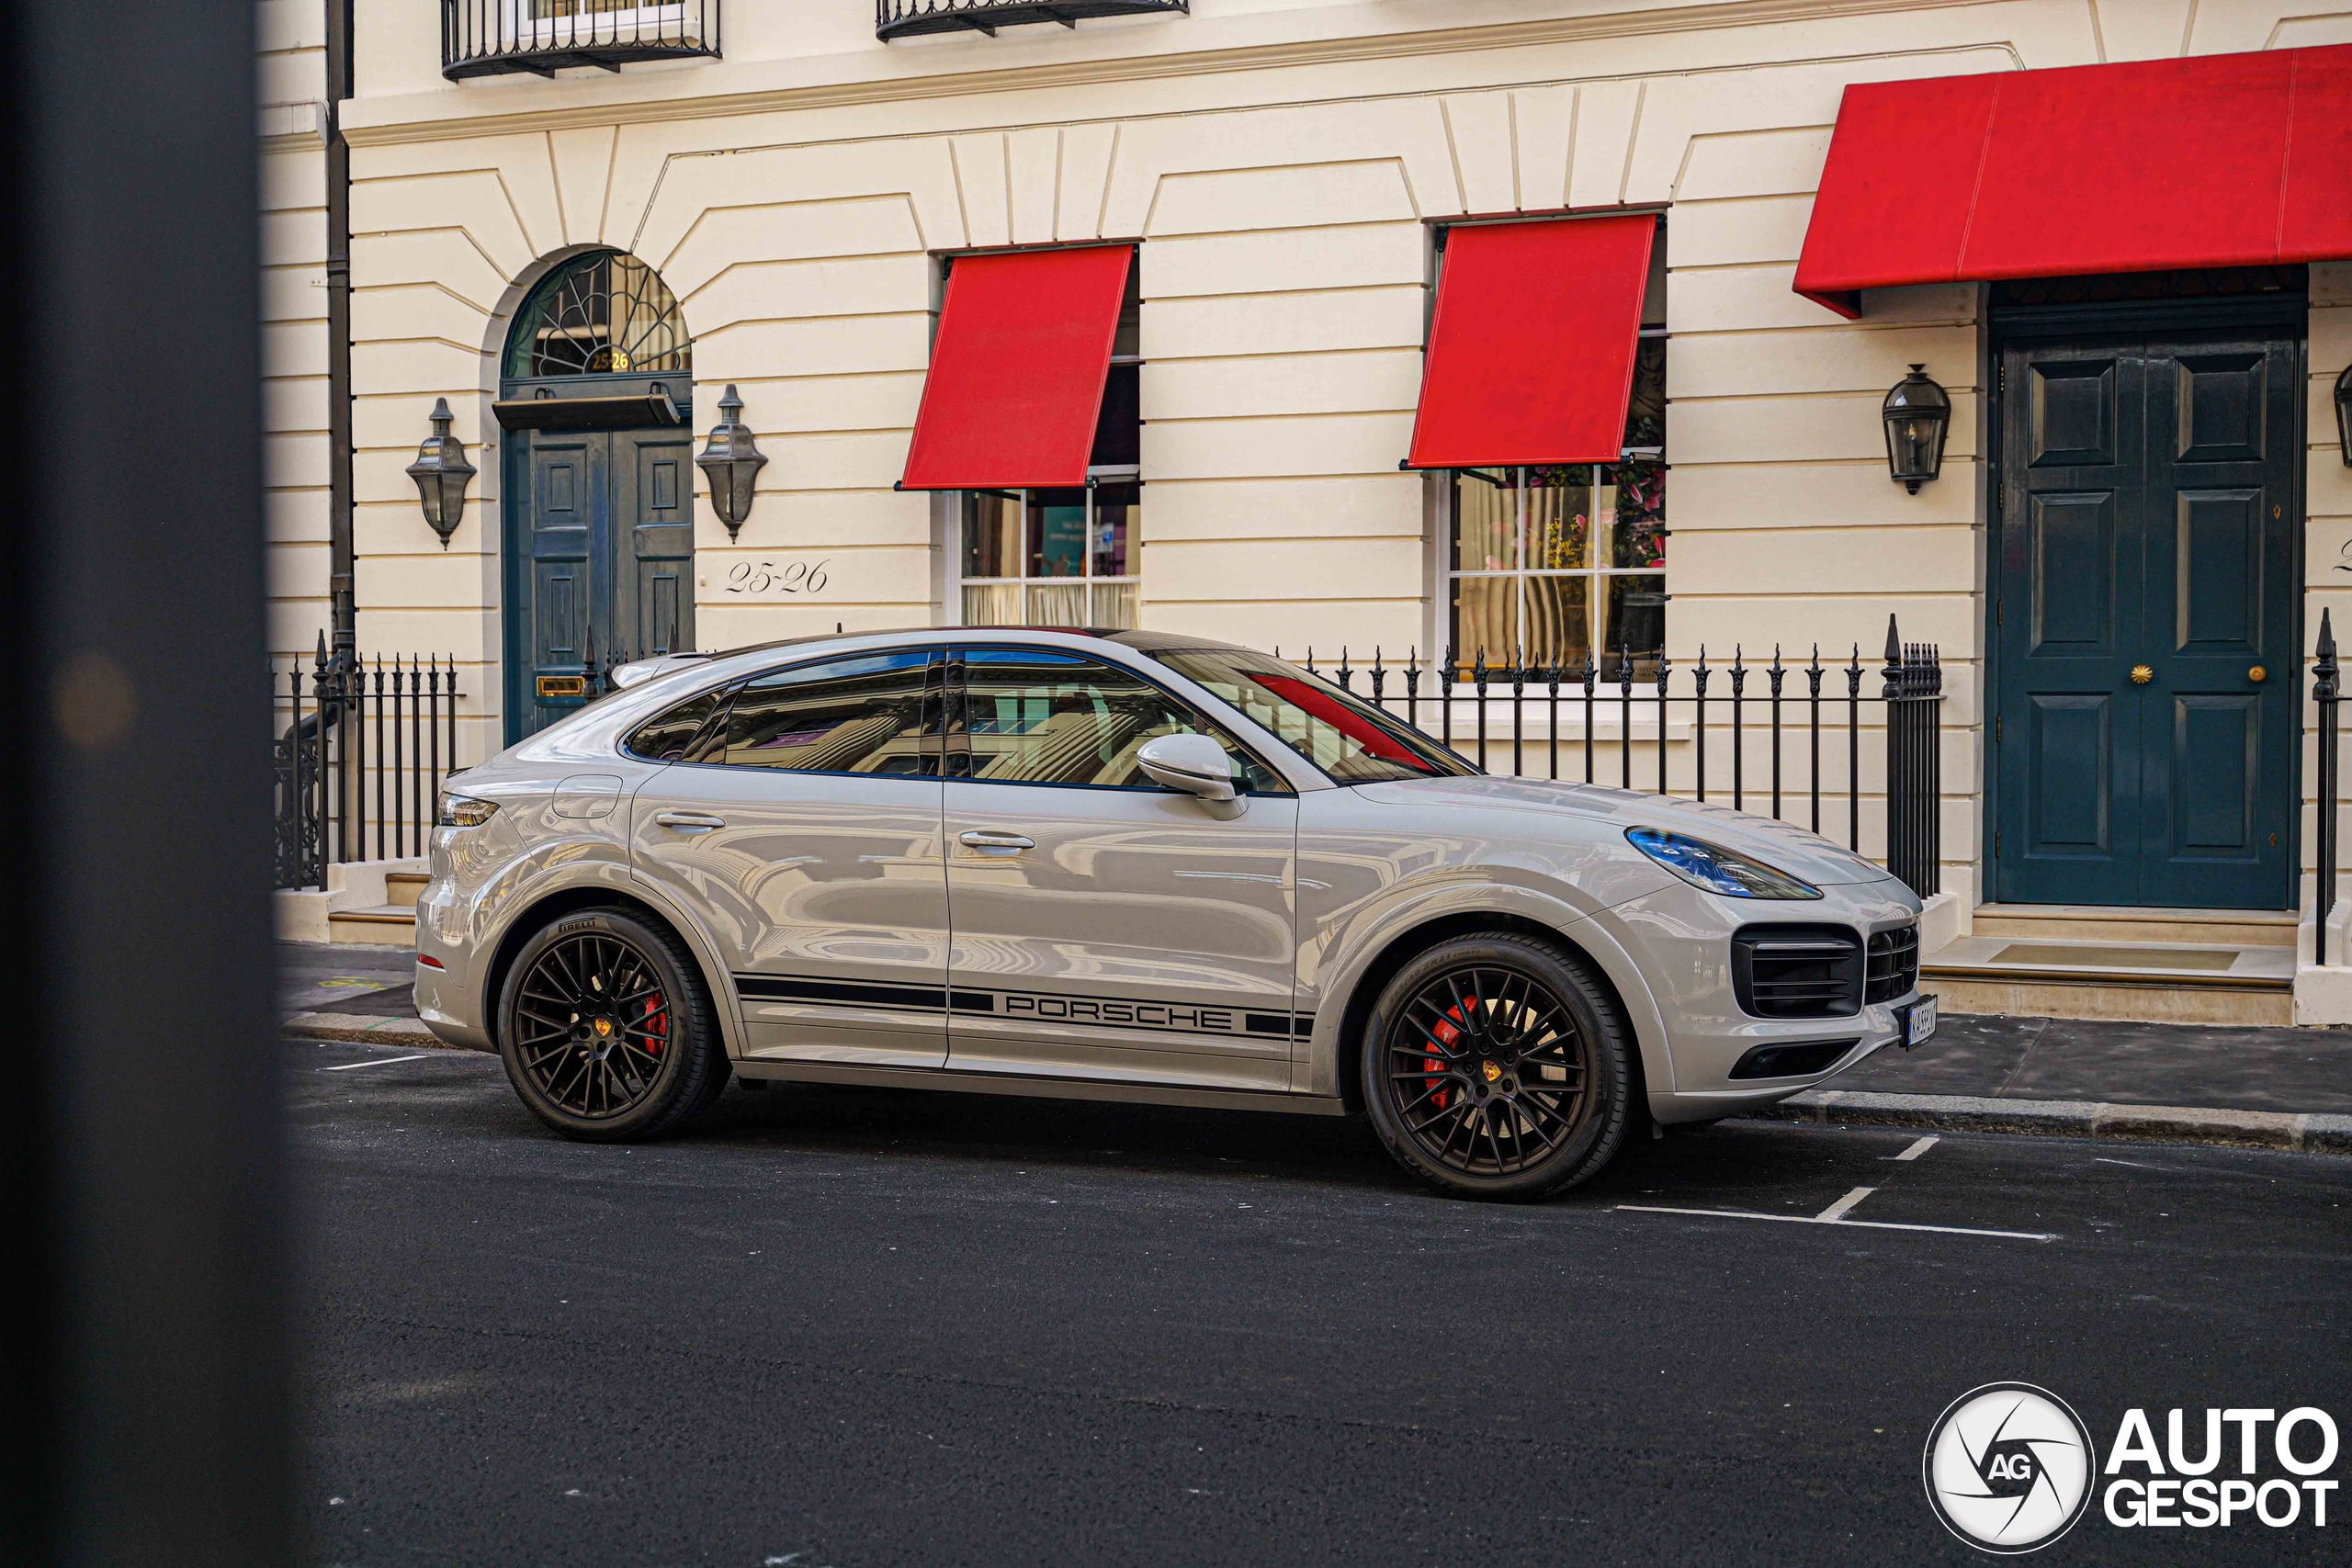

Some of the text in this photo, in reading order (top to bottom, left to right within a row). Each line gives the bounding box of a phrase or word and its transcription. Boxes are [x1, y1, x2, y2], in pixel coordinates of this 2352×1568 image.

[593, 353, 629, 369] 25-26
[724, 558, 831, 593] 25-26
[558, 917, 596, 933] PIRELLI
[1006, 996, 1232, 1030] PORSCHE
